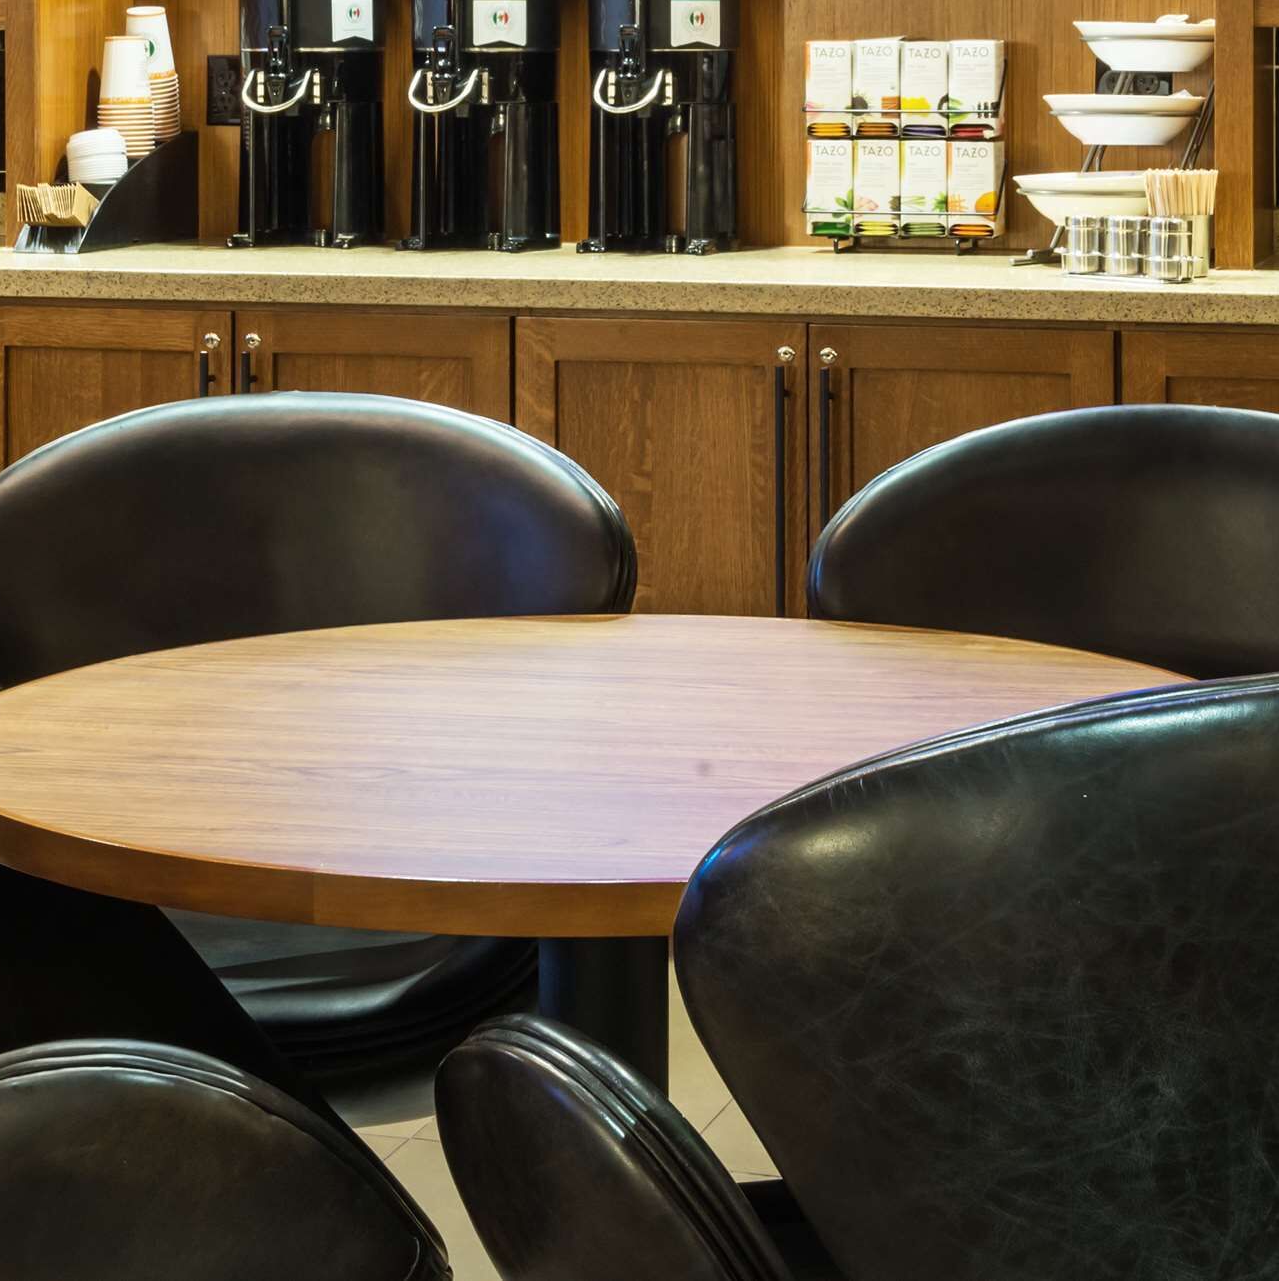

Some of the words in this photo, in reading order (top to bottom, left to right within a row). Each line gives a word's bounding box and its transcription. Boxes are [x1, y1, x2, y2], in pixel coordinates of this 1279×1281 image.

[814, 47, 846, 58] TAZO
[861, 46, 894, 57] TAZO
[908, 47, 941, 59] TAZO
[956, 46, 989, 57] TAZO
[815, 145, 847, 156] TAZO
[862, 145, 894, 157] TAZO
[908, 145, 941, 157] TAZO
[956, 147, 989, 158] TAZO
